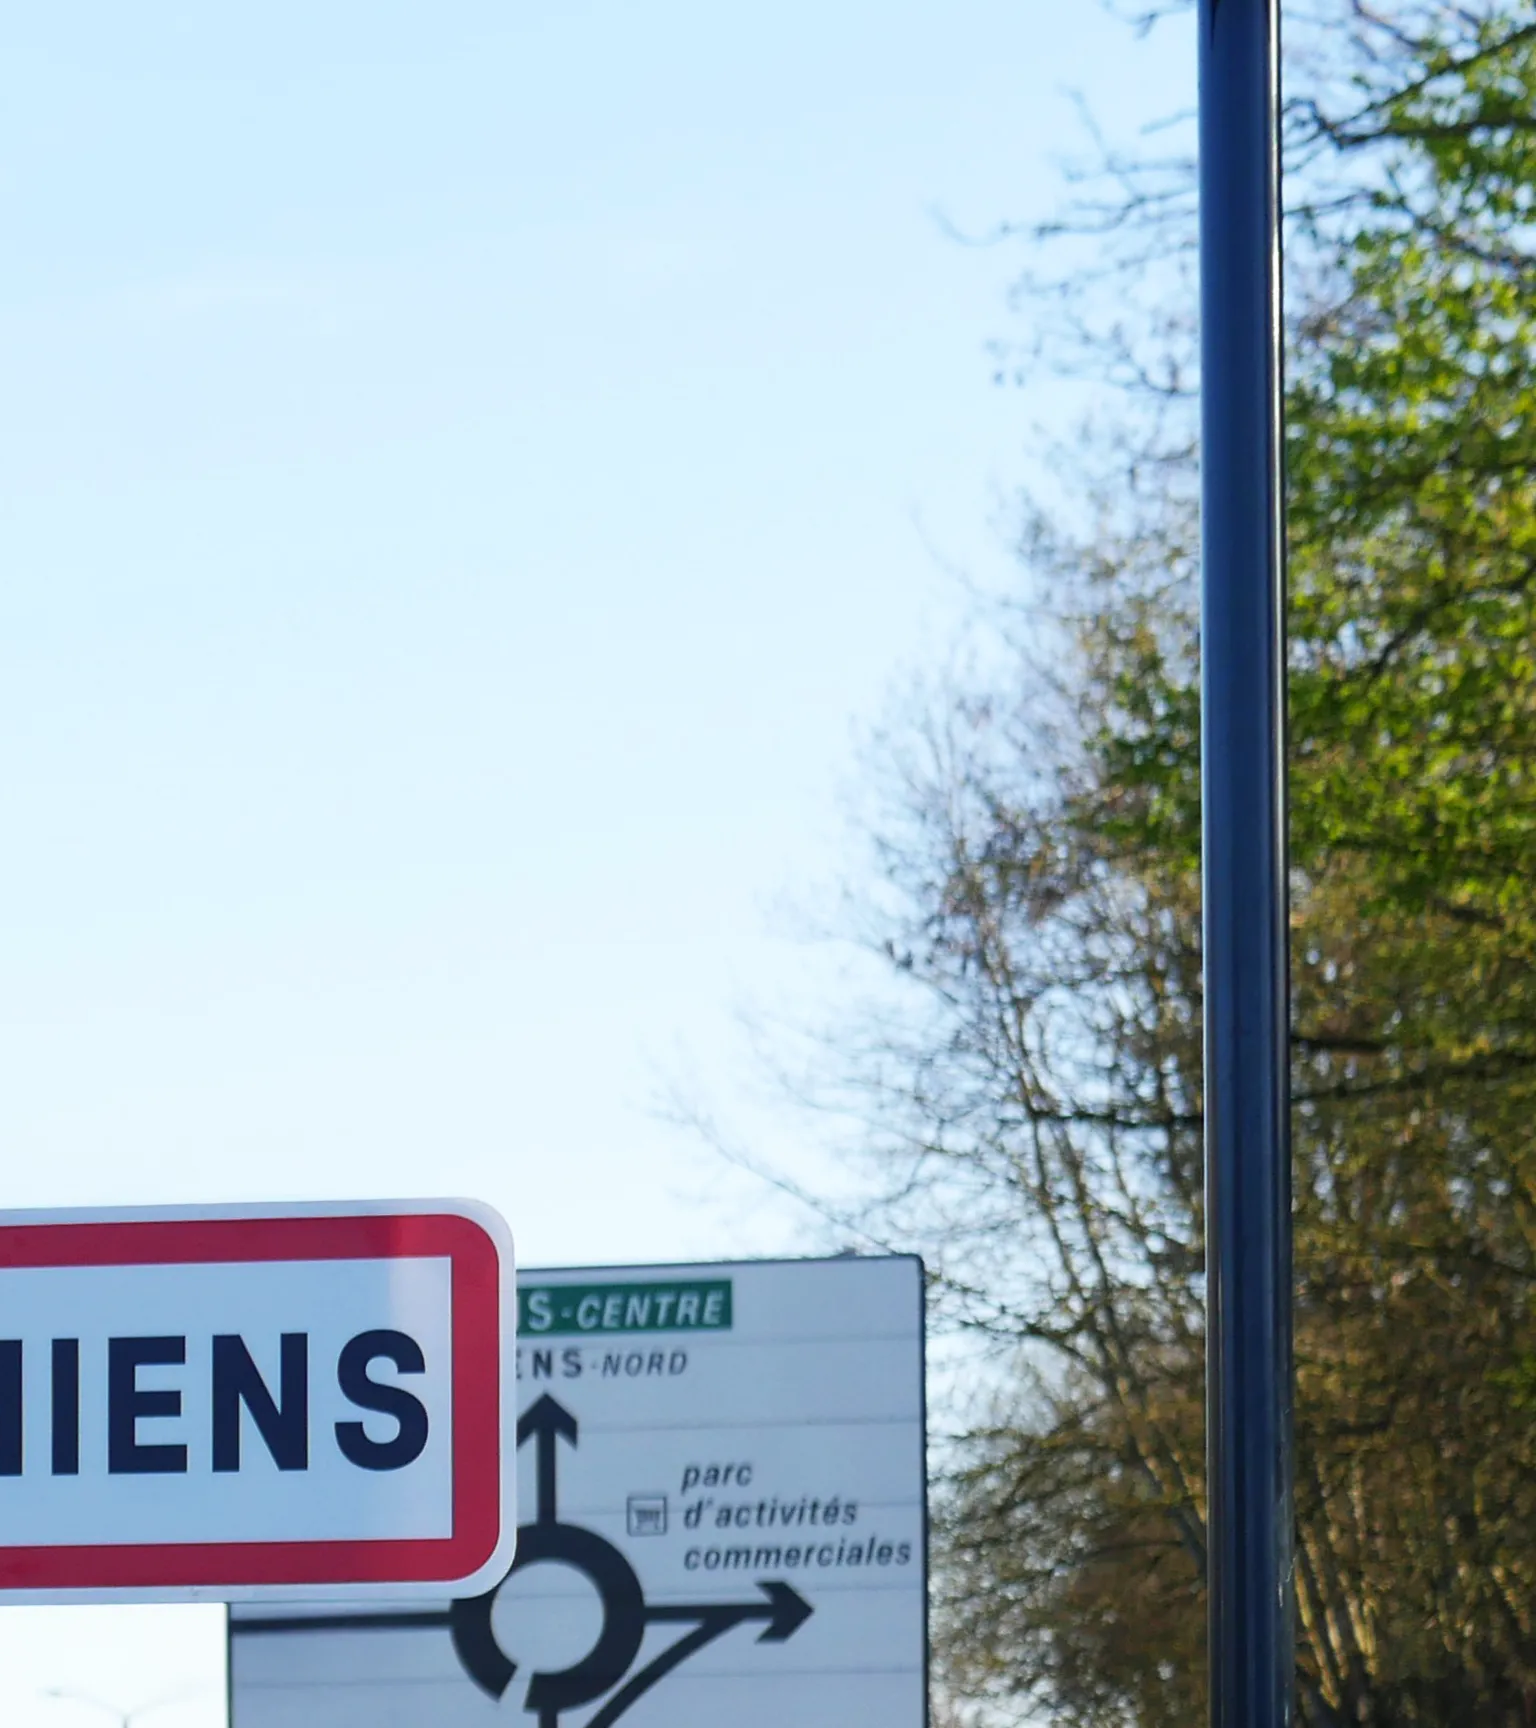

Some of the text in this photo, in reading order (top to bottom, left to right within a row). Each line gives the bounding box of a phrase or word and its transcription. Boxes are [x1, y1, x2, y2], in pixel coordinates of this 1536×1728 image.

[680, 1461, 754, 1497] parc
[683, 1496, 860, 1529] d'activités
[683, 1536, 914, 1571] commerciales
